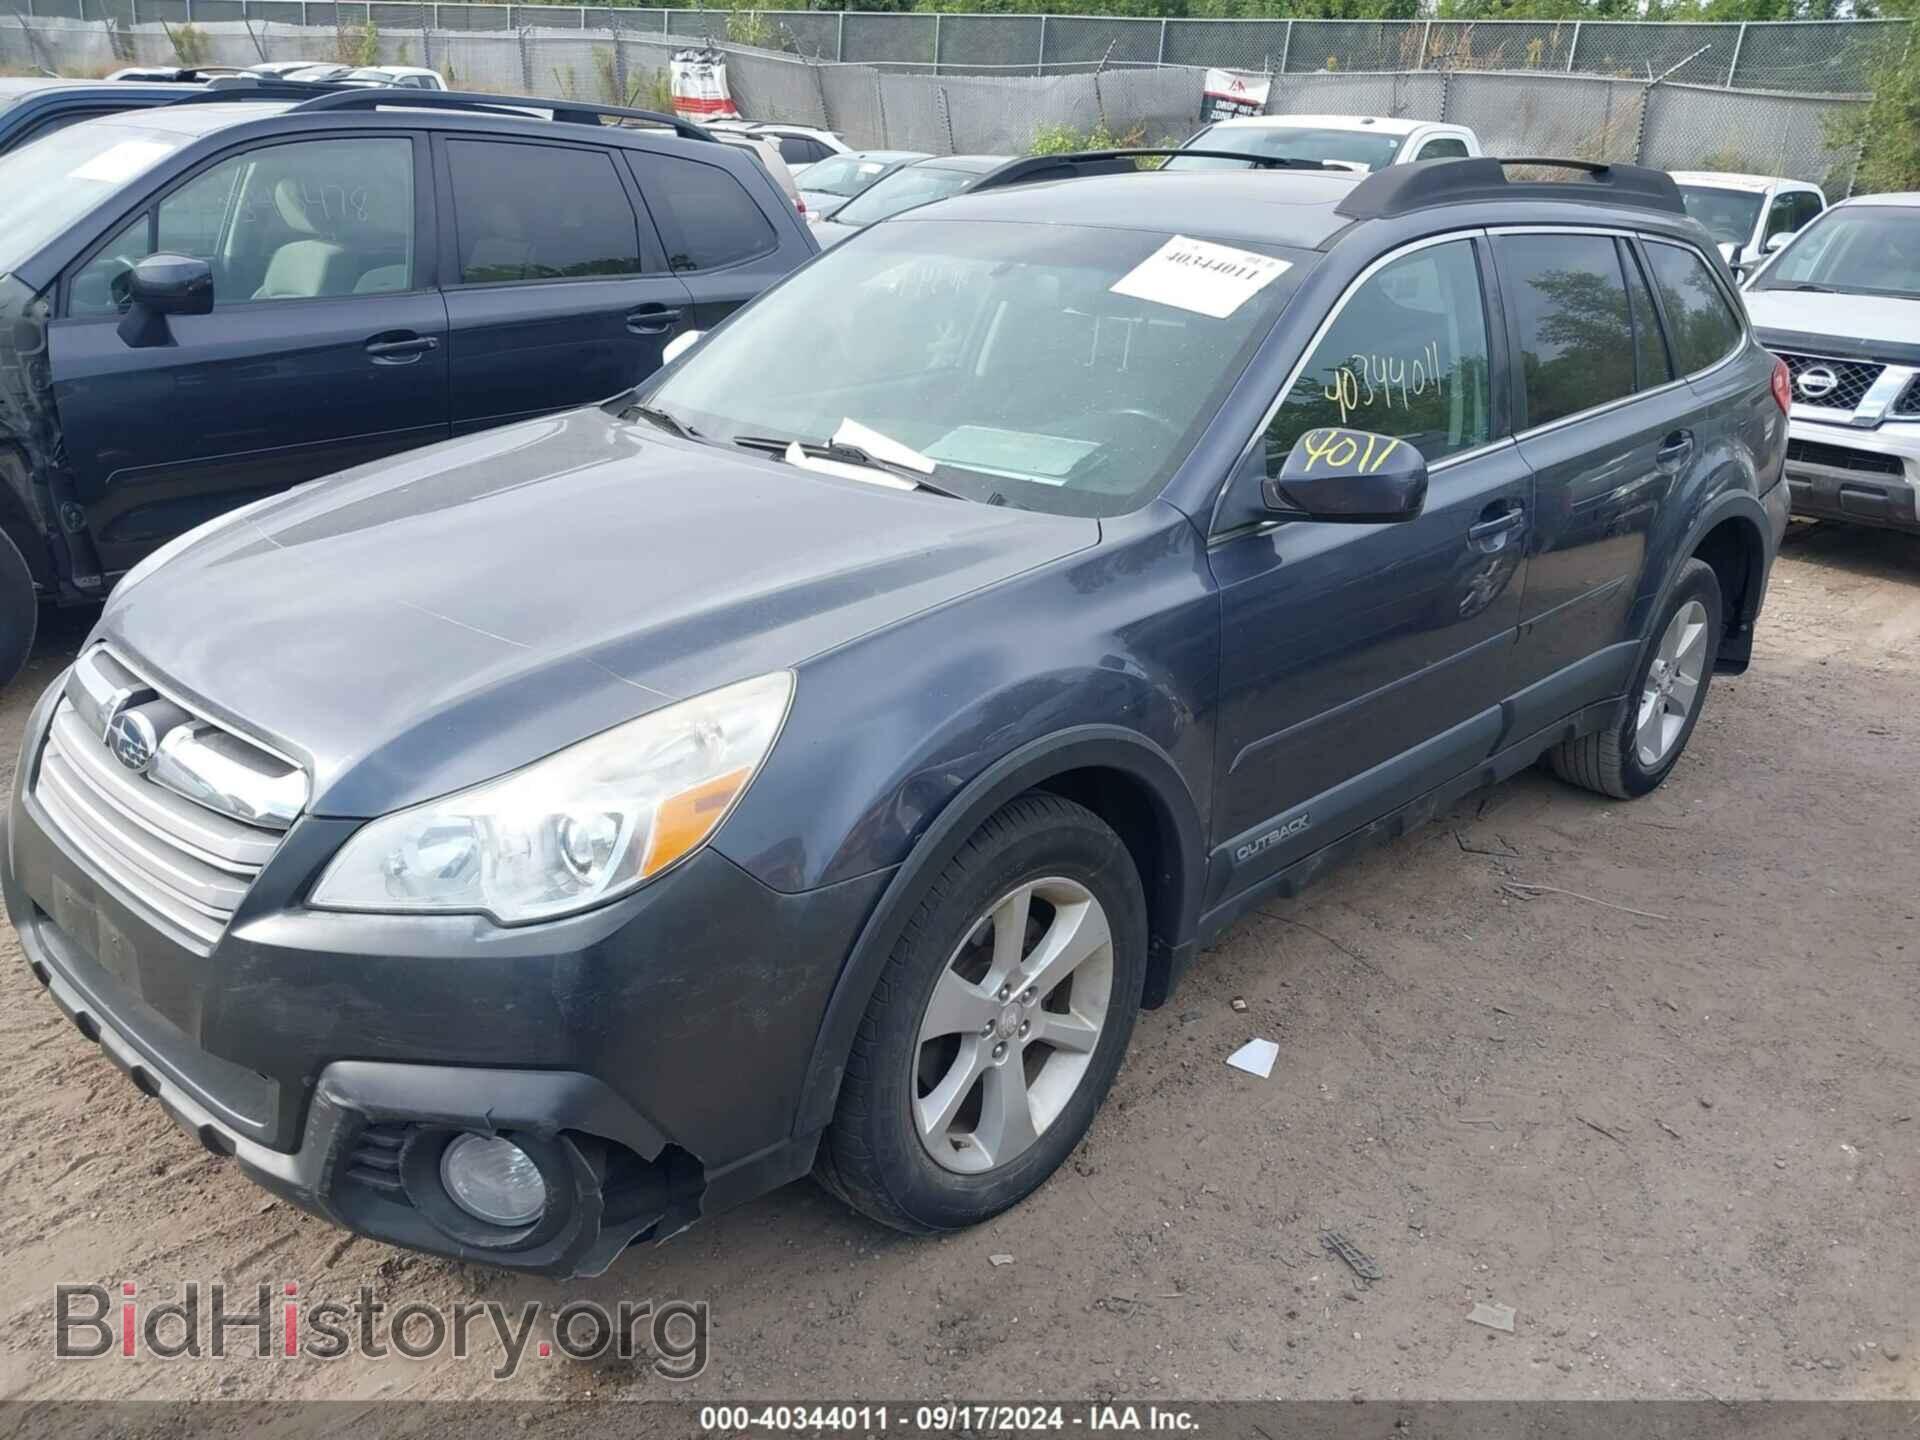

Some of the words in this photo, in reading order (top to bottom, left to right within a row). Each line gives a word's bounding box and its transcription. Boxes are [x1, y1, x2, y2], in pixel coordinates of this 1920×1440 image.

[1210, 109, 1233, 121] ZONE
[1215, 99, 1238, 111] DROP
[1165, 250, 1259, 281] 40344011
[1324, 340, 1442, 424] 40344011
[1303, 431, 1399, 474] 4011
[1236, 813, 1309, 861] OUTBACK
